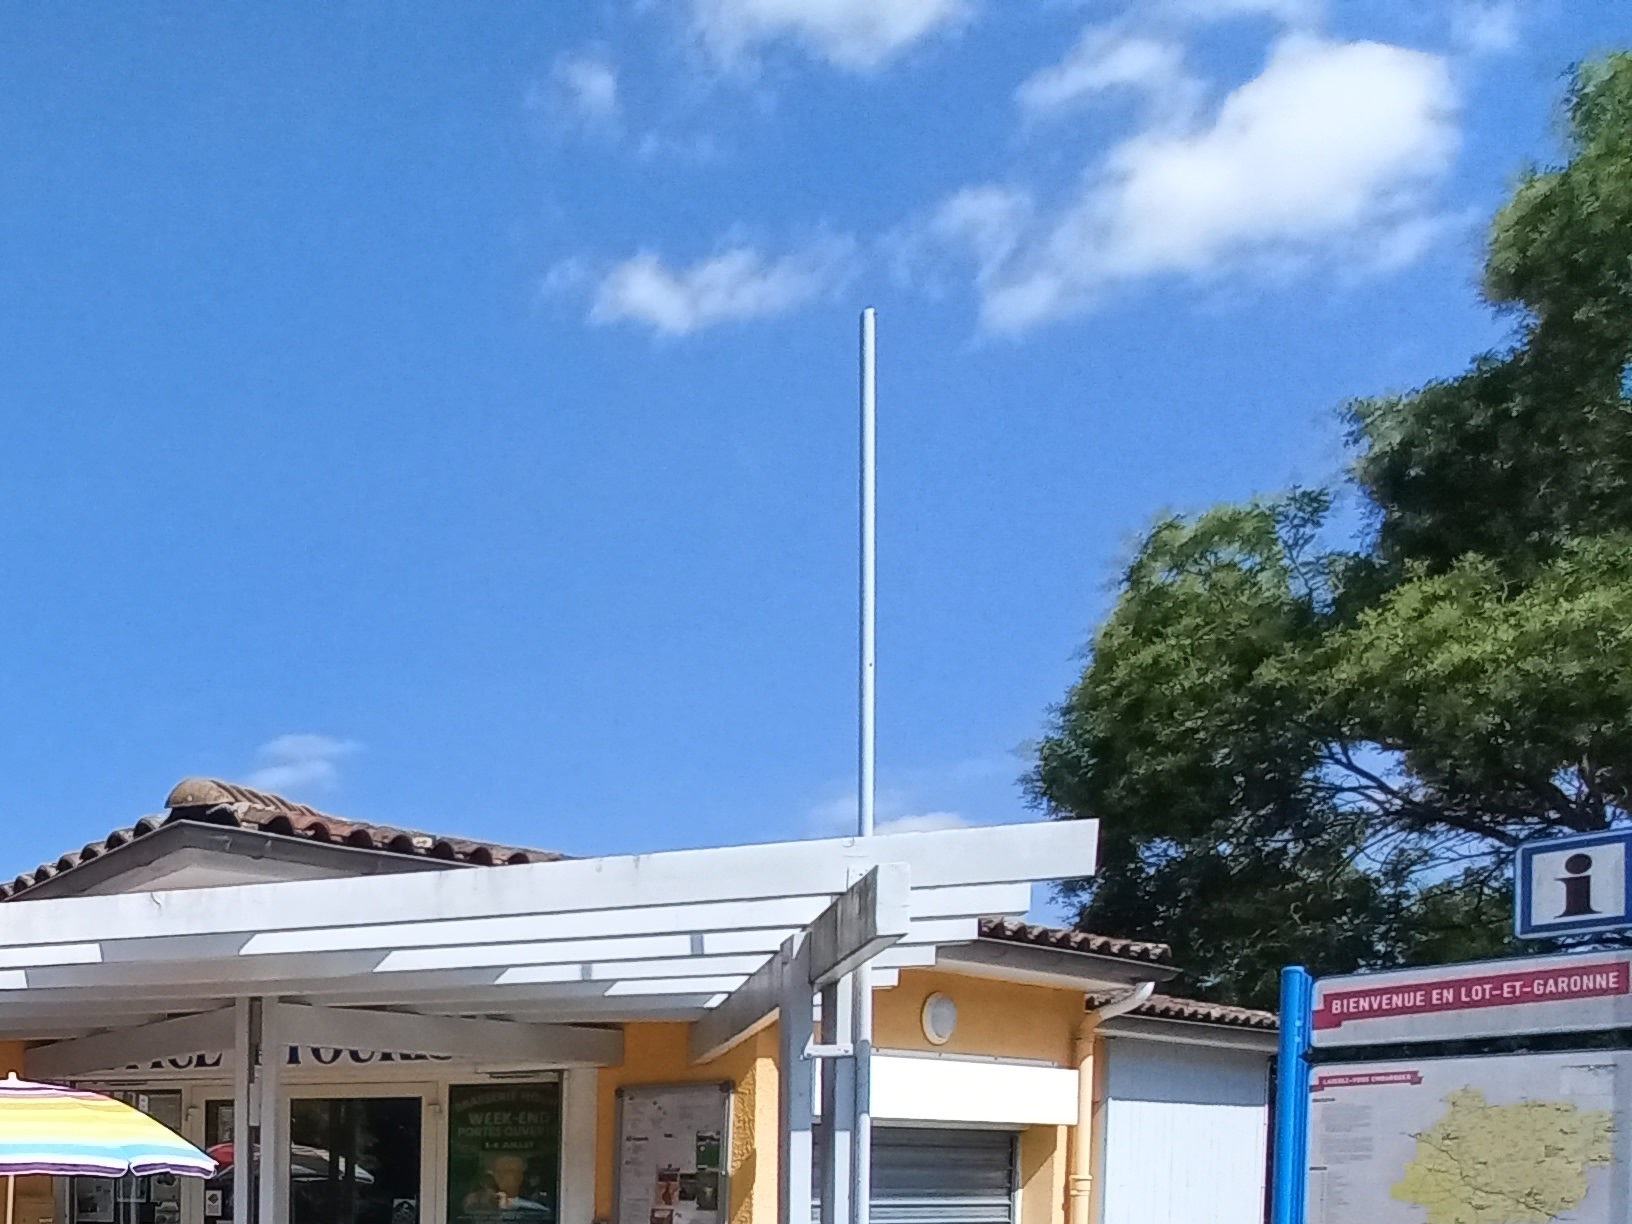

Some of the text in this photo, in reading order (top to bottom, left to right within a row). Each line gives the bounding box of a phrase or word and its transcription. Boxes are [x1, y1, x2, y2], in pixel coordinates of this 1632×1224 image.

[1331, 971, 1620, 1014] BIENVENUE EN LOT-ET-GARONNE
[467, 1111, 550, 1125] WEEK-END
